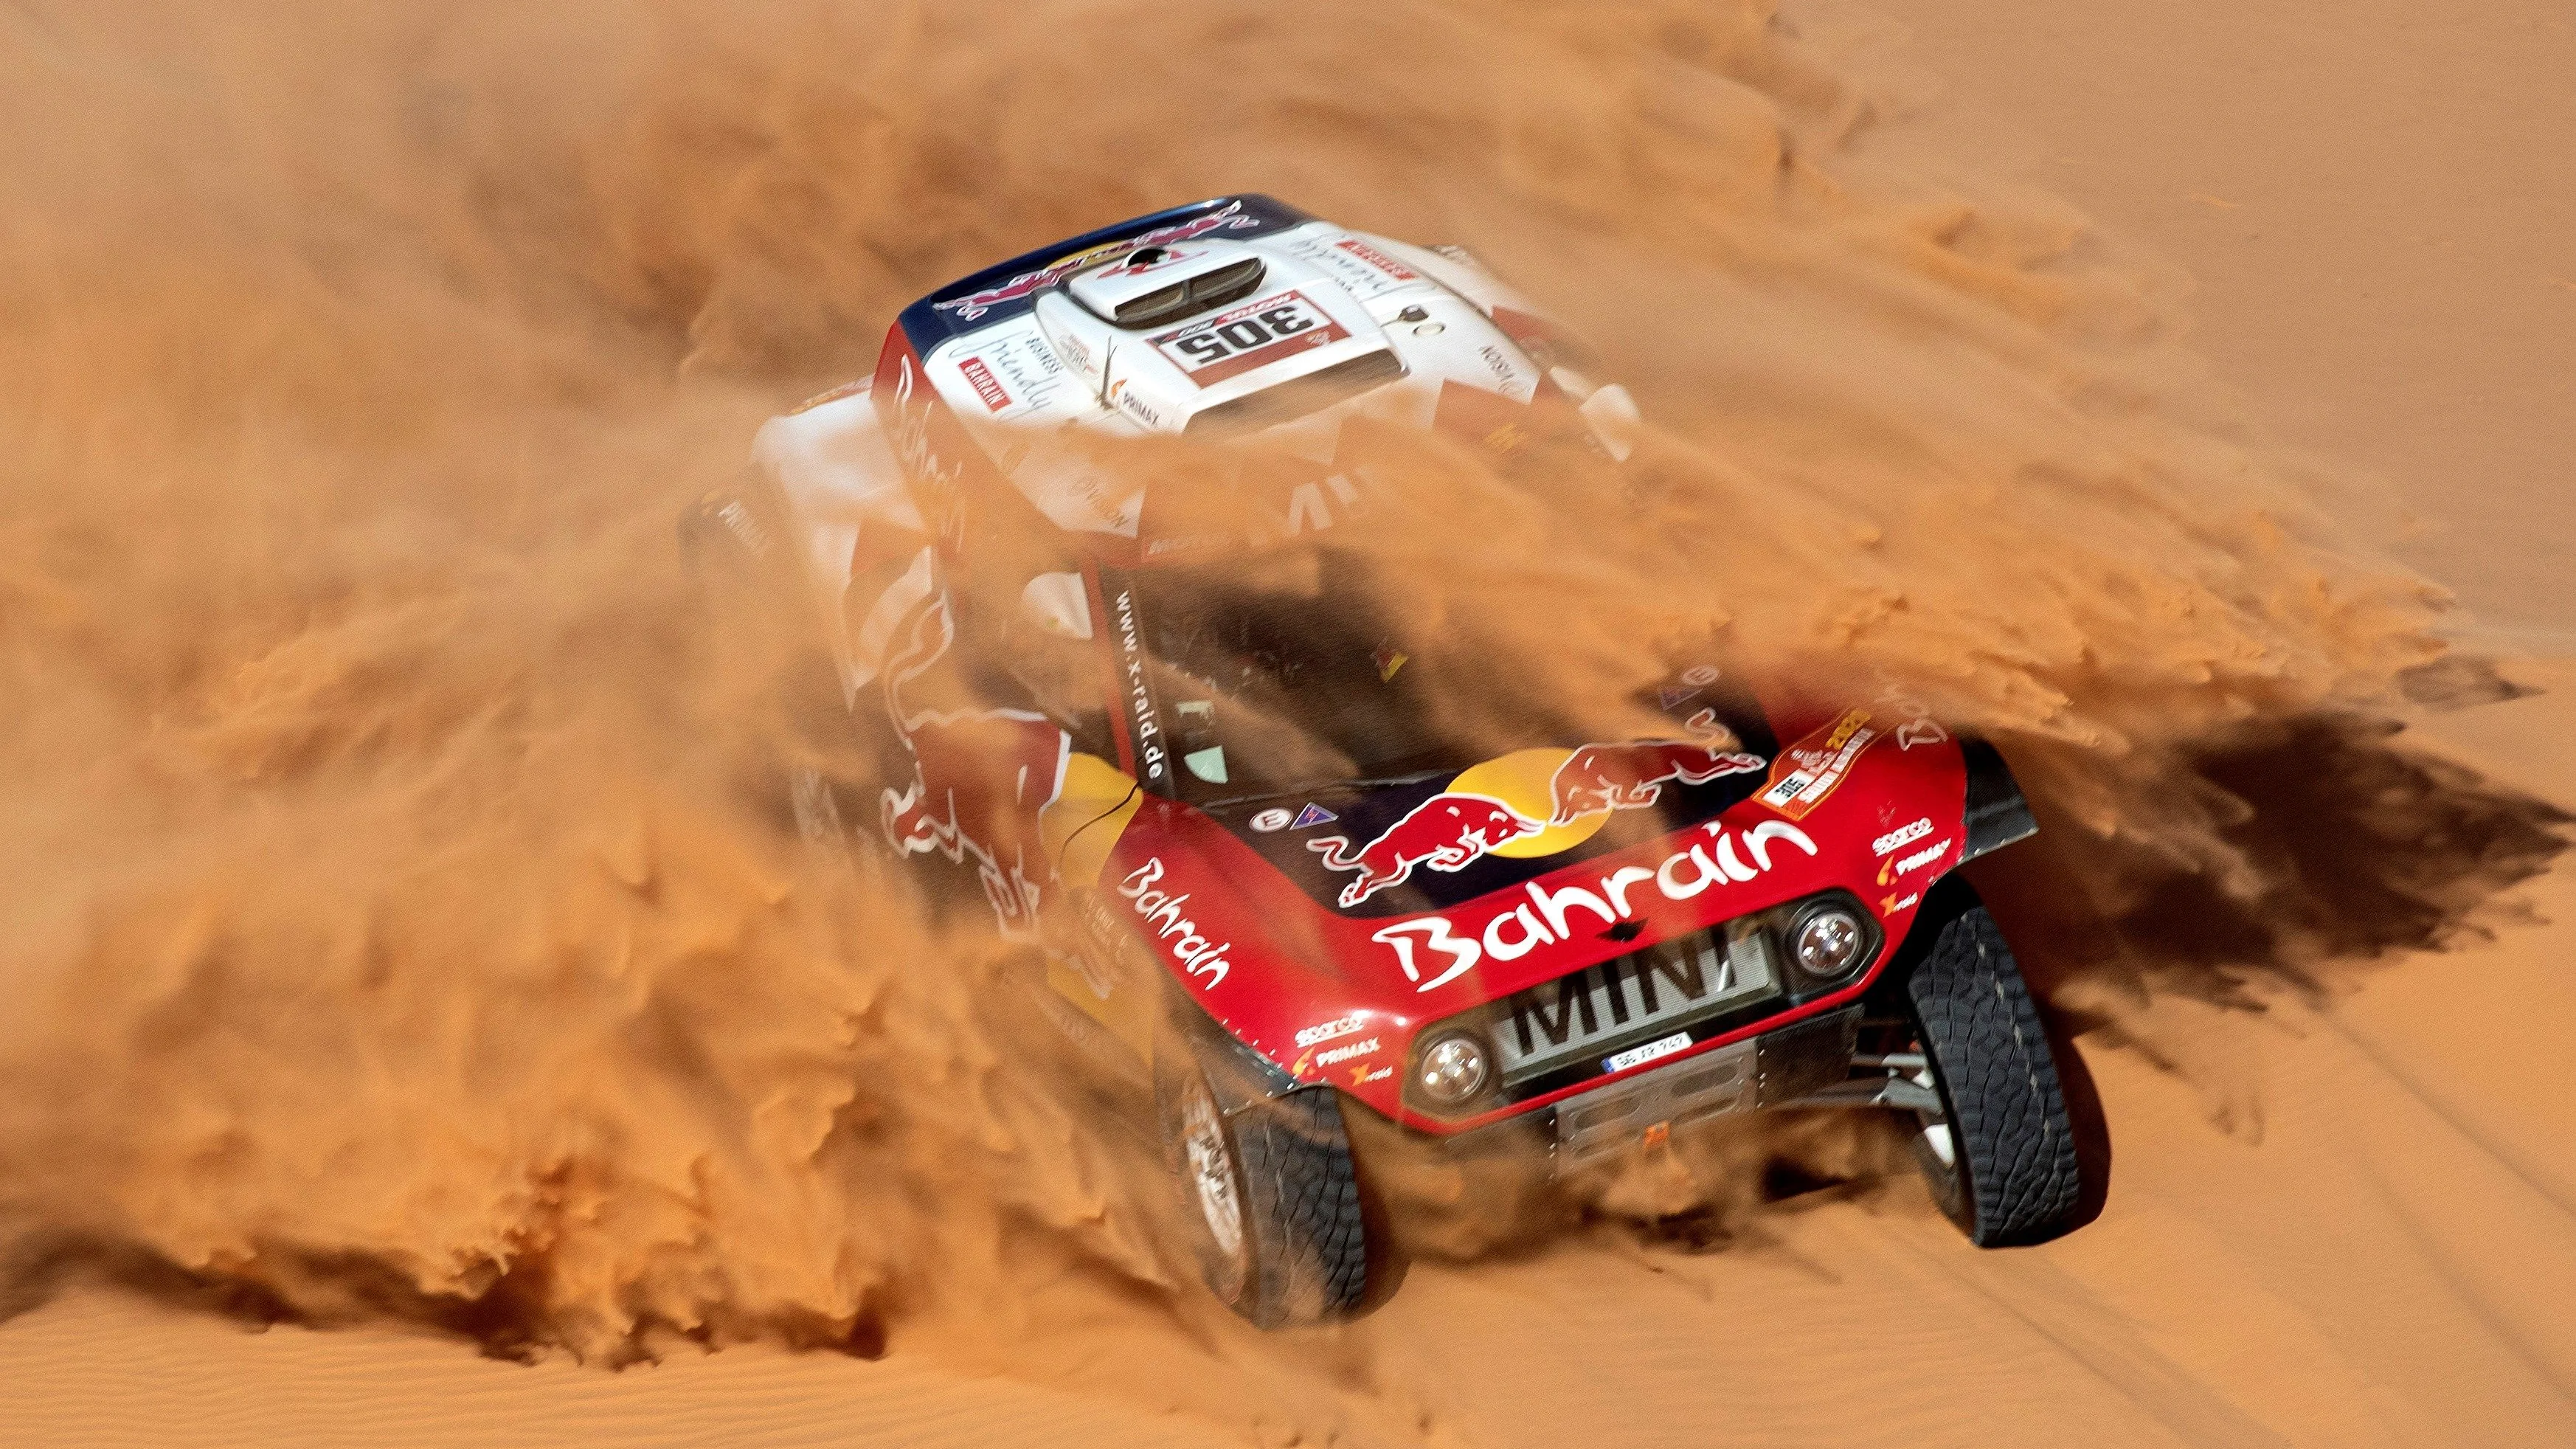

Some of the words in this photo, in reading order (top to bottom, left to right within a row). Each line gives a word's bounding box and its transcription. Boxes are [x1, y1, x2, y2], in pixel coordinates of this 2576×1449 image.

[948, 330, 1062, 421] friendly
[1176, 306, 1313, 363] 305
[964, 362, 1005, 406] BAHRAIN
[1115, 591, 1163, 779] www.x-raid.de
[1117, 857, 1231, 991] Bahrain
[1371, 817, 1818, 993] Bahrain
[1295, 1014, 1364, 1048] sparco
[1514, 928, 1737, 1055] MINI
[1315, 1037, 1381, 1068] PRIMAX
